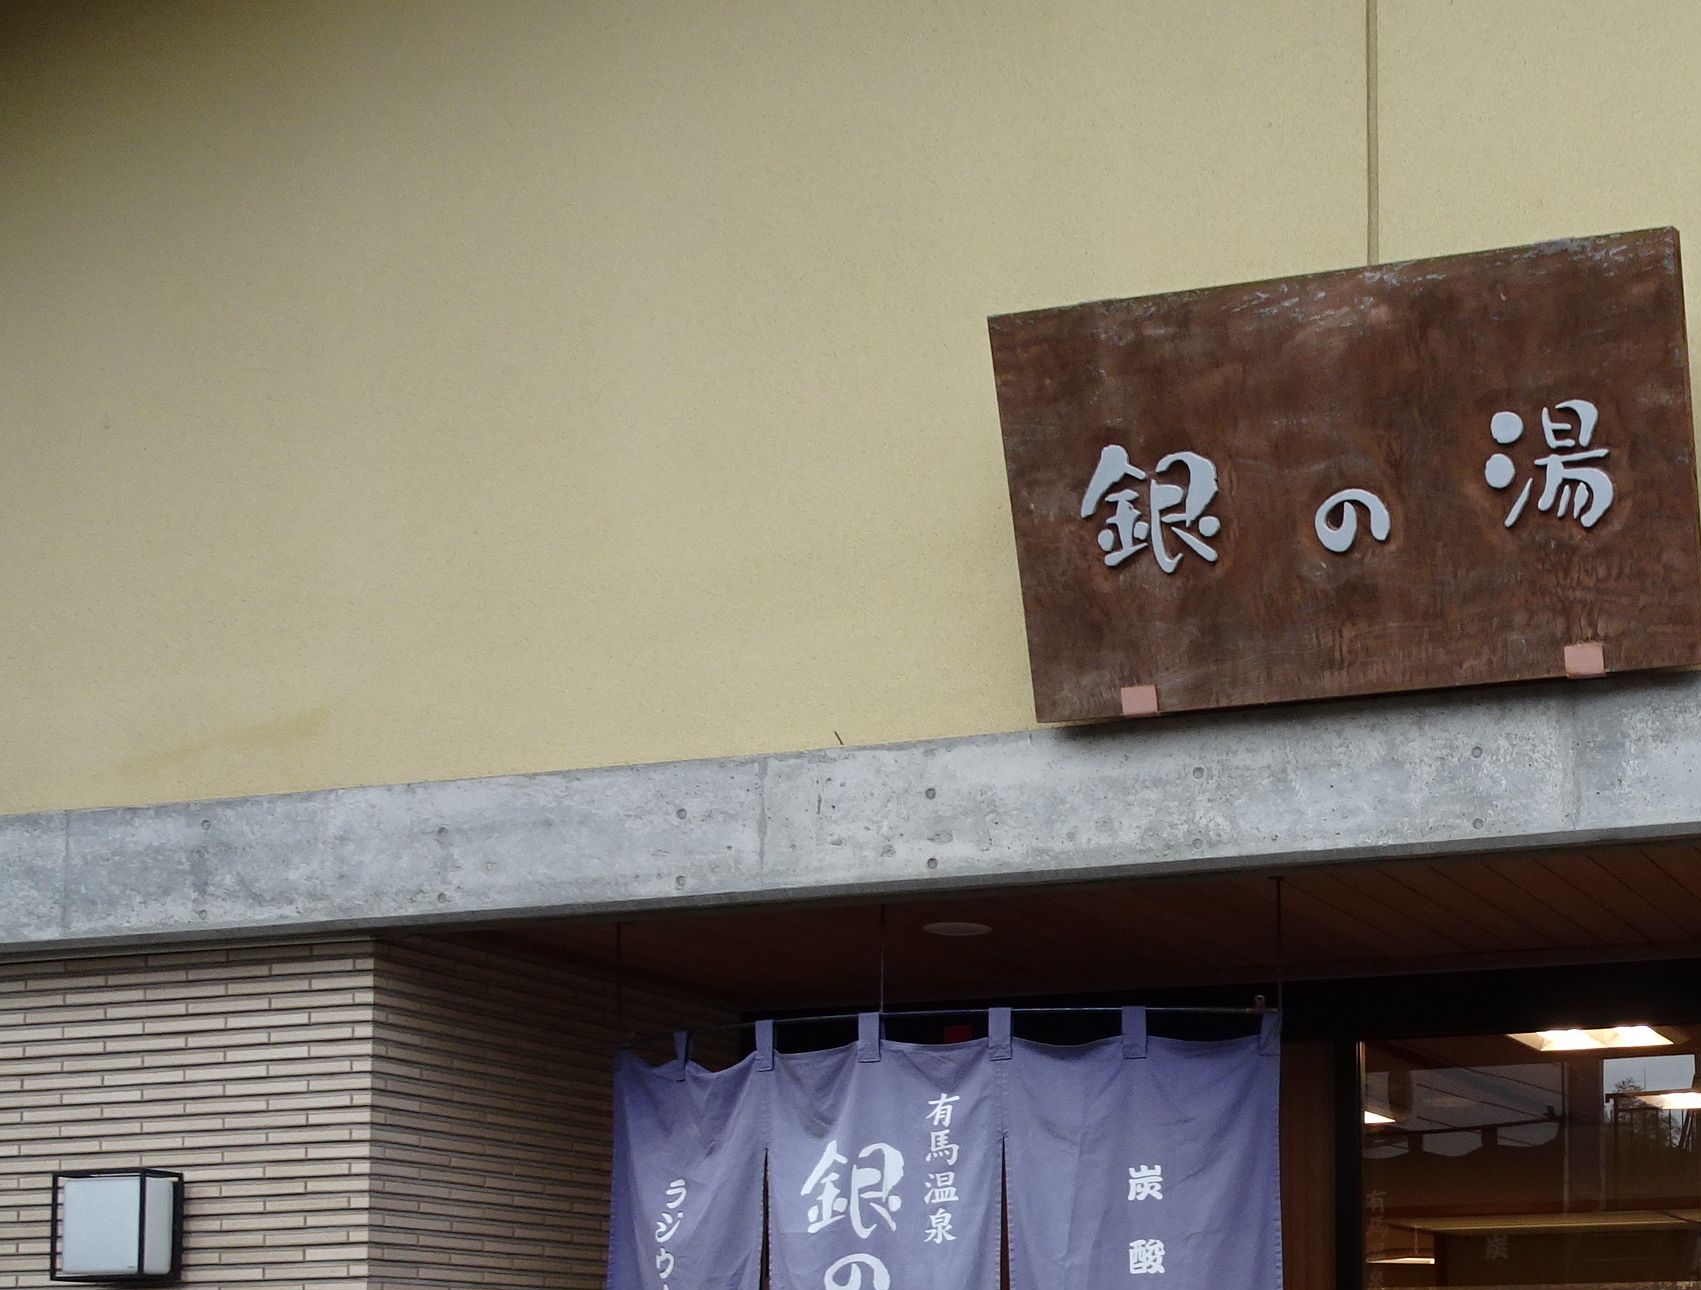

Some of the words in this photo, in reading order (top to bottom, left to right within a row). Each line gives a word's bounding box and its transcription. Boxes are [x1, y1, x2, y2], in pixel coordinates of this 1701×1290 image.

[1080, 399, 1614, 573] 銀の湯
[923, 1092, 961, 1243] 有馬温泉
